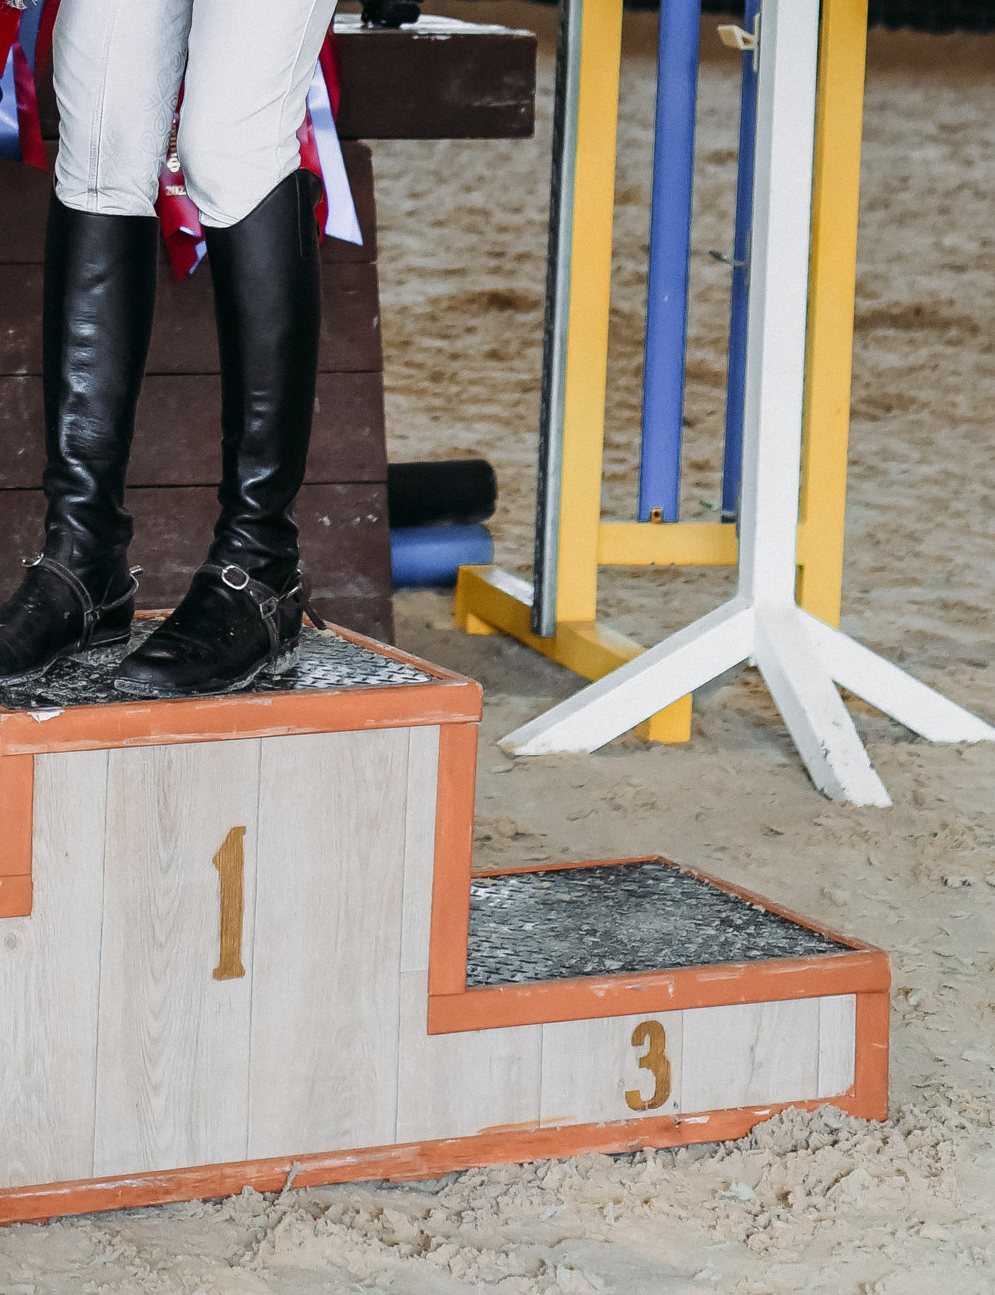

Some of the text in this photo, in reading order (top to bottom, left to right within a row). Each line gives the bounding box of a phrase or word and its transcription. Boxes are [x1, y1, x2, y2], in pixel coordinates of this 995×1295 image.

[165, 185, 187, 196] 202
[212, 825, 247, 980] 1
[624, 1019, 671, 1111] 3
